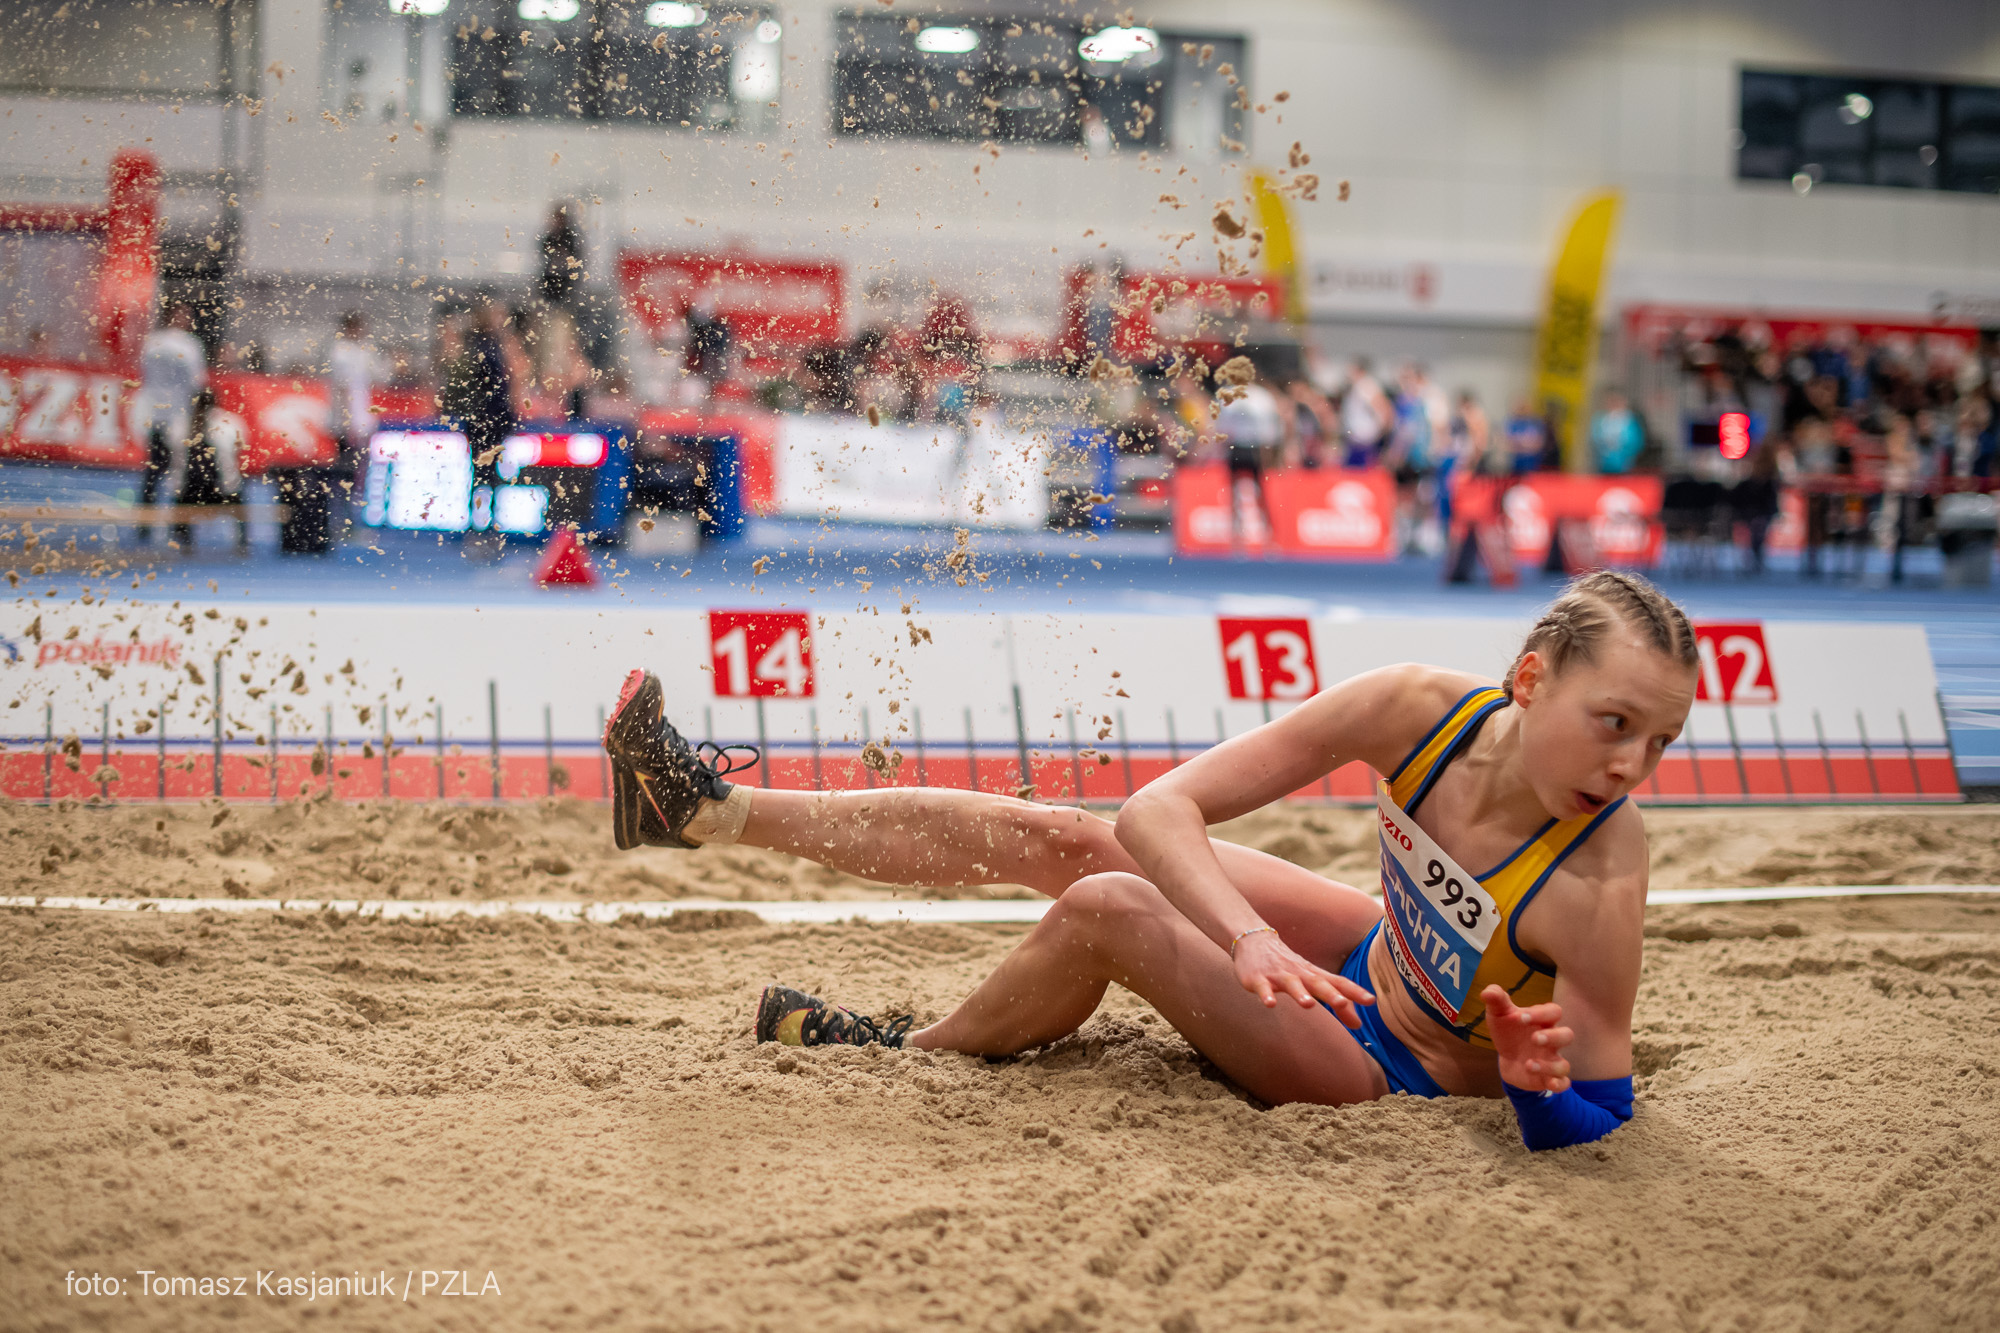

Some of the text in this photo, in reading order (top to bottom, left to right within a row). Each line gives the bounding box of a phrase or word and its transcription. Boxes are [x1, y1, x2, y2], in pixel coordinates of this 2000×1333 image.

[36, 634, 182, 671] polanik
[713, 626, 809, 696] 14
[1226, 630, 1314, 698] 13
[1698, 635, 1774, 699] 12
[1423, 859, 1482, 929] 993
[1408, 957, 1425, 982] Polski
[1425, 981, 1437, 998] U18
[1439, 1000, 1453, 1018] U20
